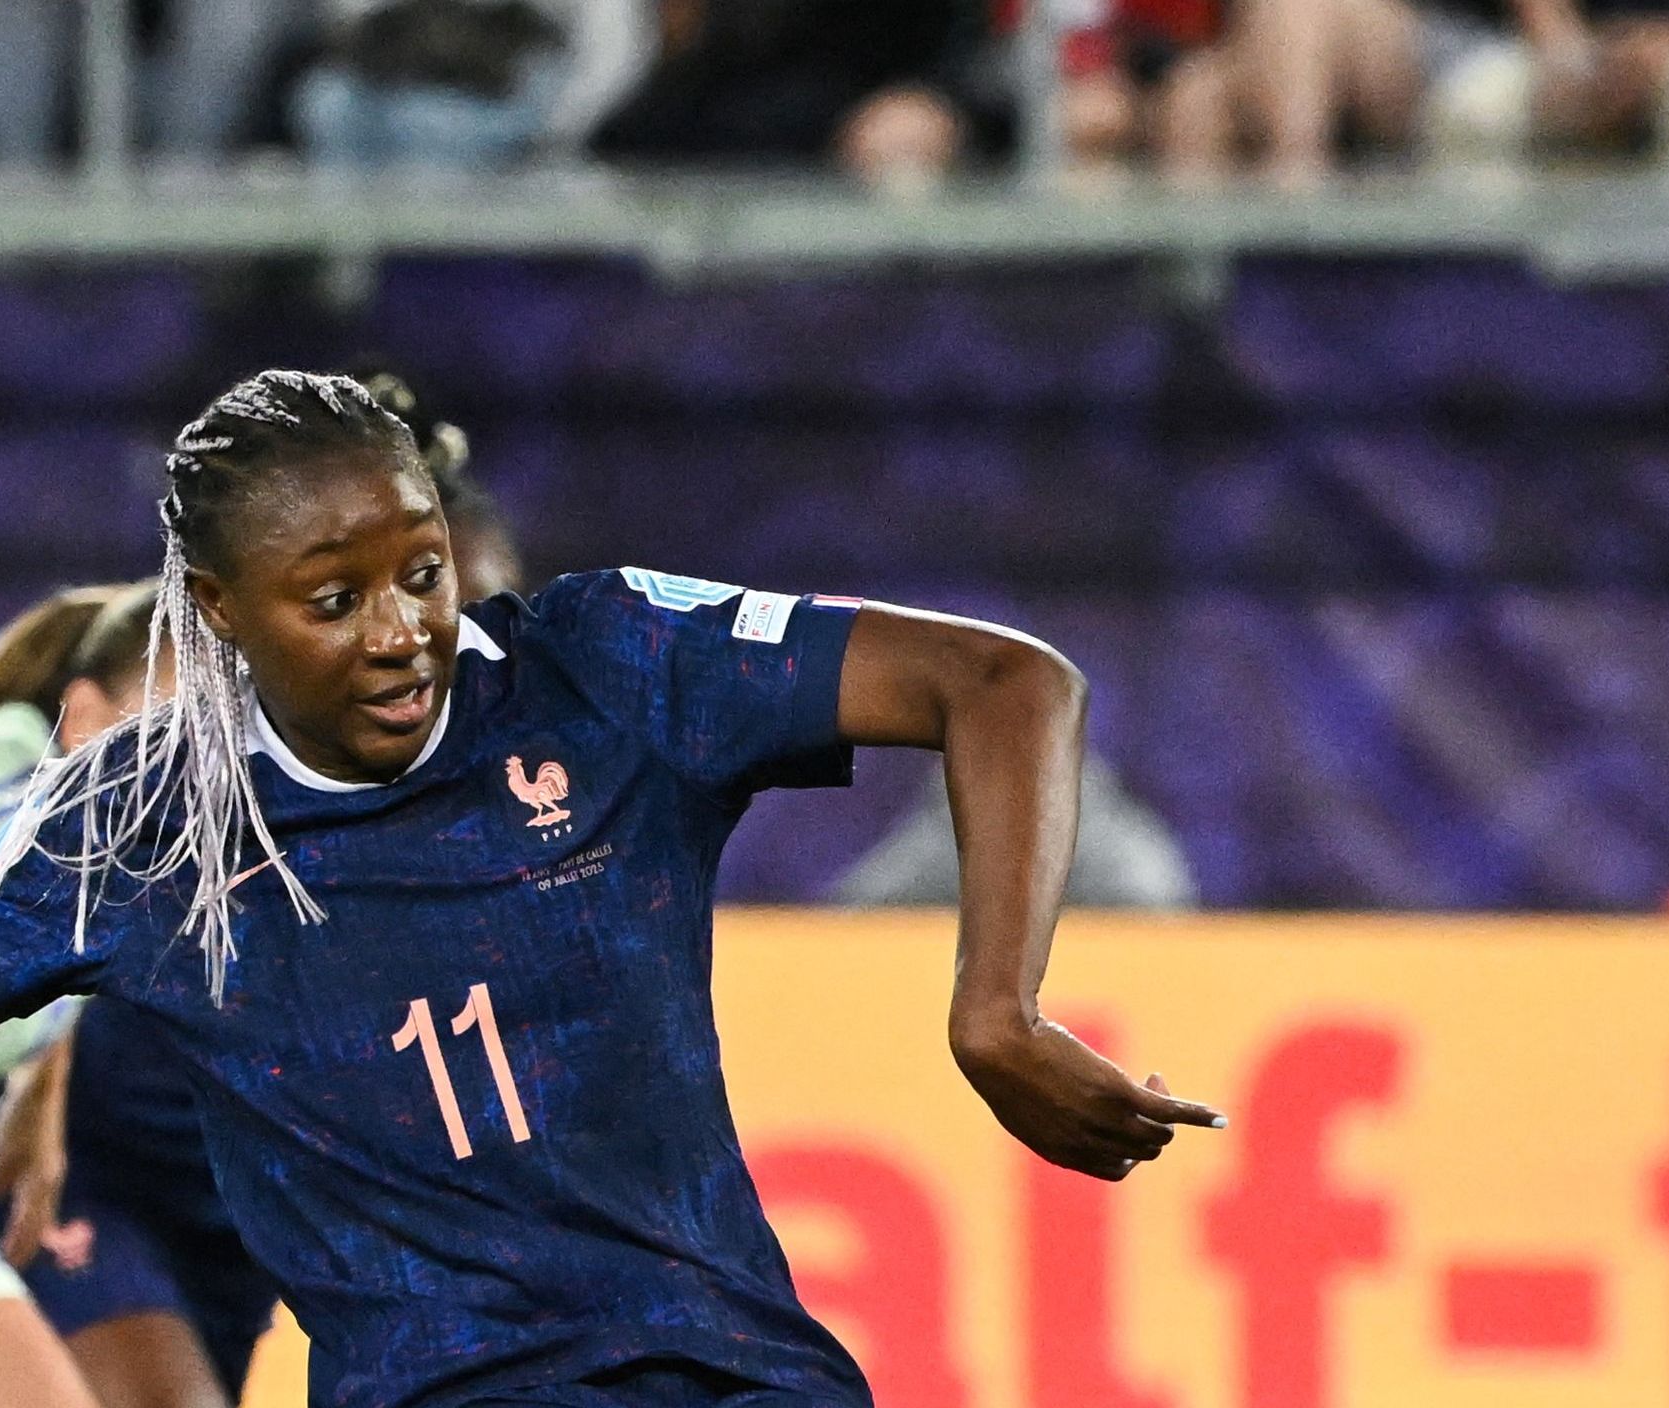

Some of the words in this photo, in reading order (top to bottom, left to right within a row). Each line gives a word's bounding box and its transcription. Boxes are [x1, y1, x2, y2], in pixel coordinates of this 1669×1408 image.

[537, 878, 551, 892] 09
[579, 862, 605, 879] 2025
[392, 982, 531, 1161] 11
